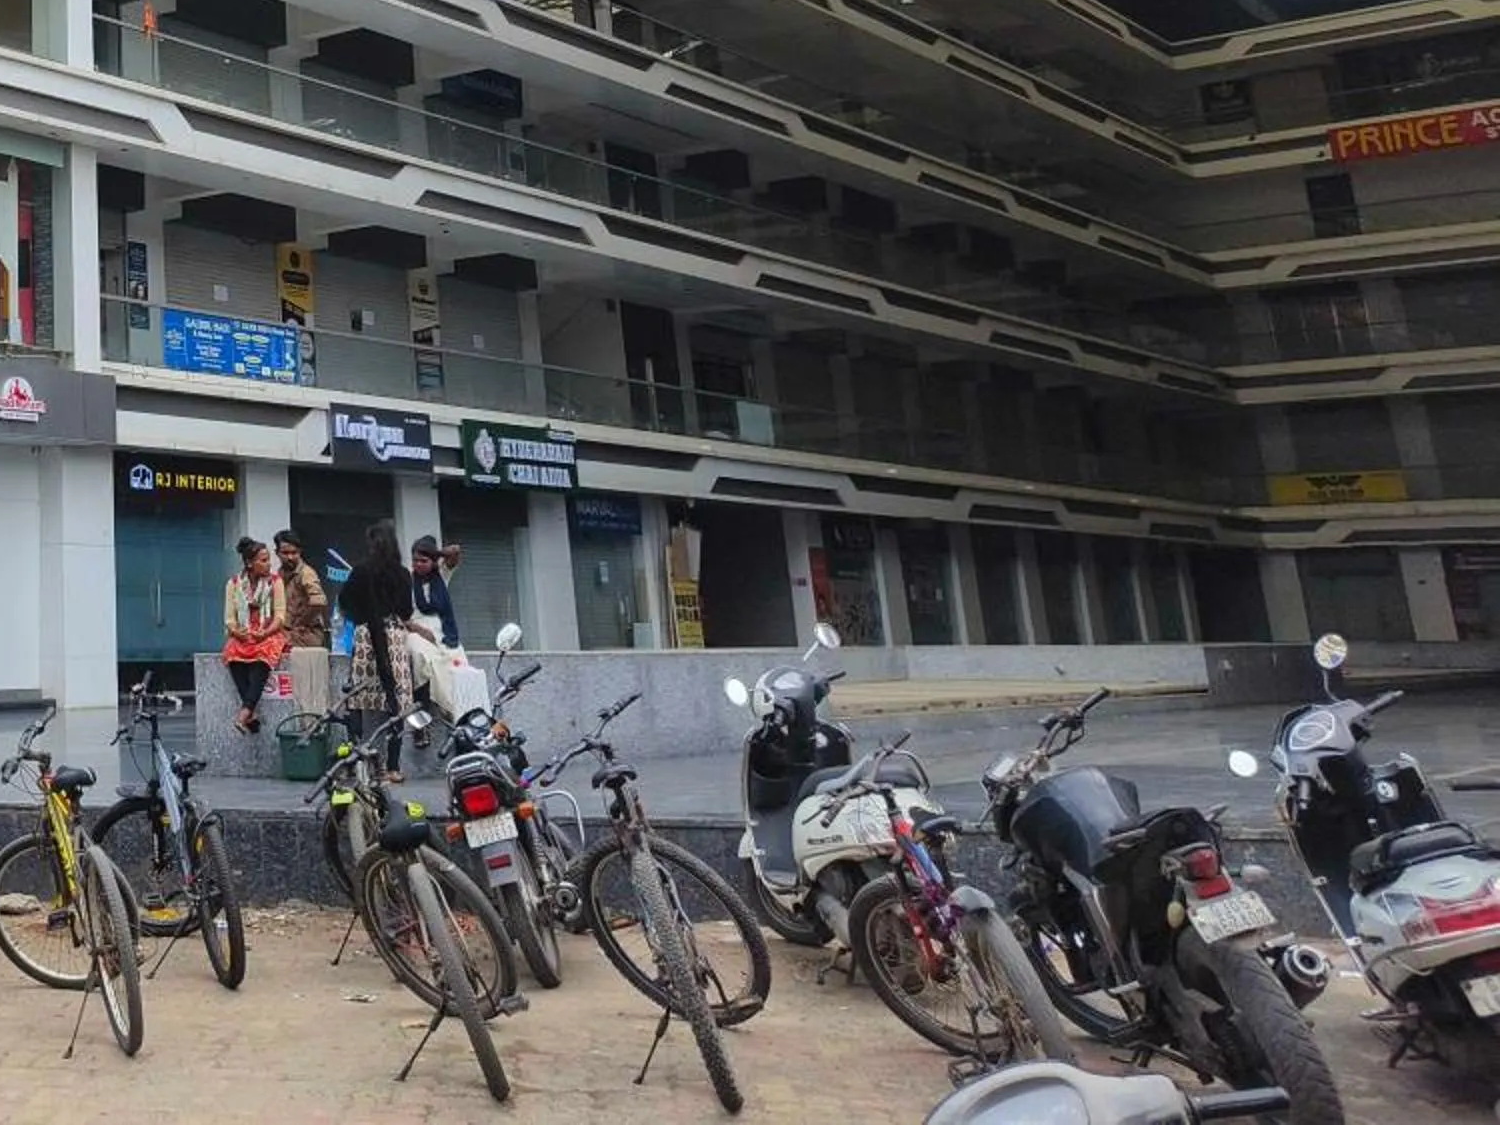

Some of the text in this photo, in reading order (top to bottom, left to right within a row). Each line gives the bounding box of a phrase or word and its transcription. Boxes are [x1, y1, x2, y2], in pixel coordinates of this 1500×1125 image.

[1337, 115, 1463, 159] PRINCE
[156, 472, 235, 492] RJ INTERIOR
